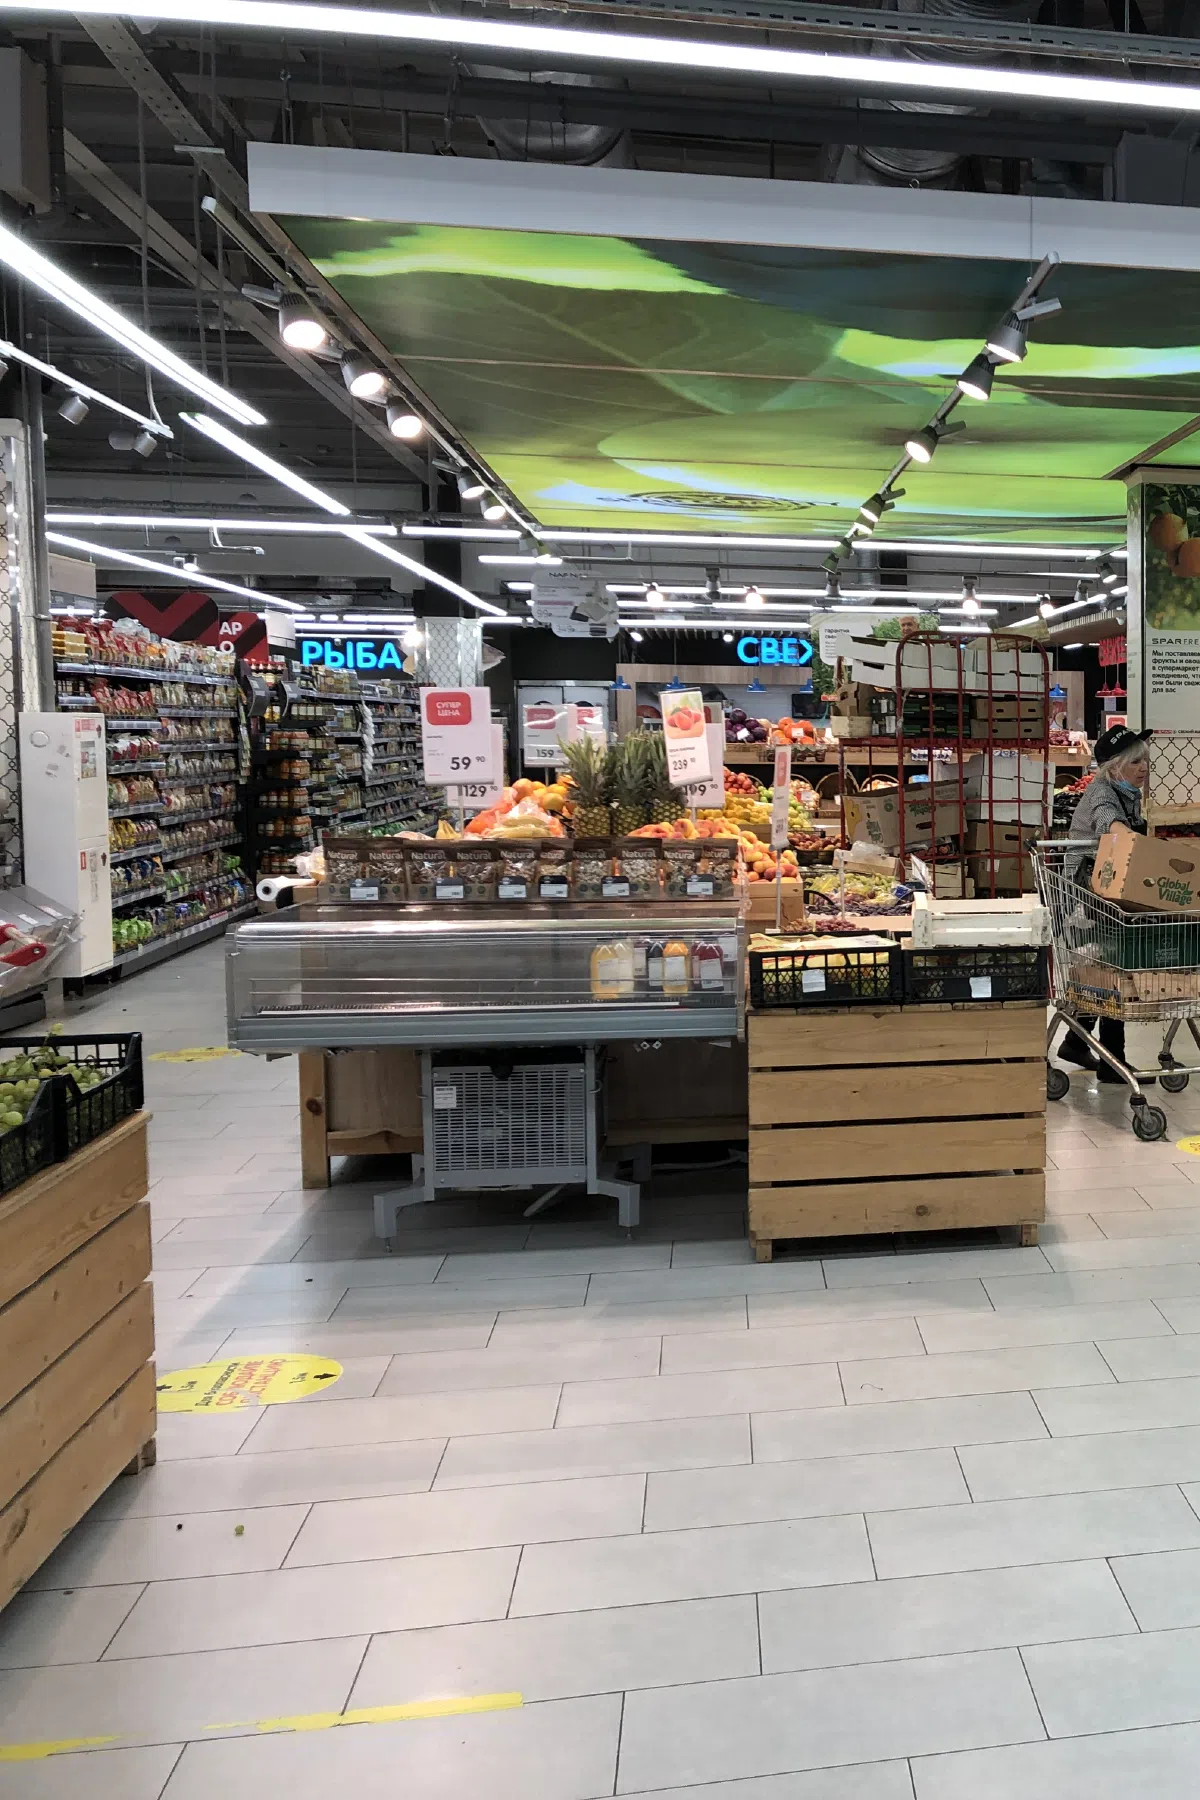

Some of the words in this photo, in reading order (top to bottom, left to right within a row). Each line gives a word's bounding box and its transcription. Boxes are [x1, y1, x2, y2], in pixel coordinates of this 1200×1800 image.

[219, 621, 242, 636] АР
[302, 640, 403, 669] РЫБА
[436, 701, 461, 709] СУПЕР
[437, 709, 461, 717] ЦЕНА
[1110, 728, 1129, 745] SPA
[535, 749, 555, 758] 159
[450, 756, 472, 770] 59
[475, 755, 486, 763] 90
[672, 759, 688, 771] 239
[463, 784, 487, 798] 129
[369, 852, 404, 860] Natural
[457, 852, 492, 860] Natural
[621, 850, 657, 859] Natural
[663, 850, 696, 860] Natural
[1157, 877, 1191, 891] Global
[1158, 888, 1193, 906] Village
